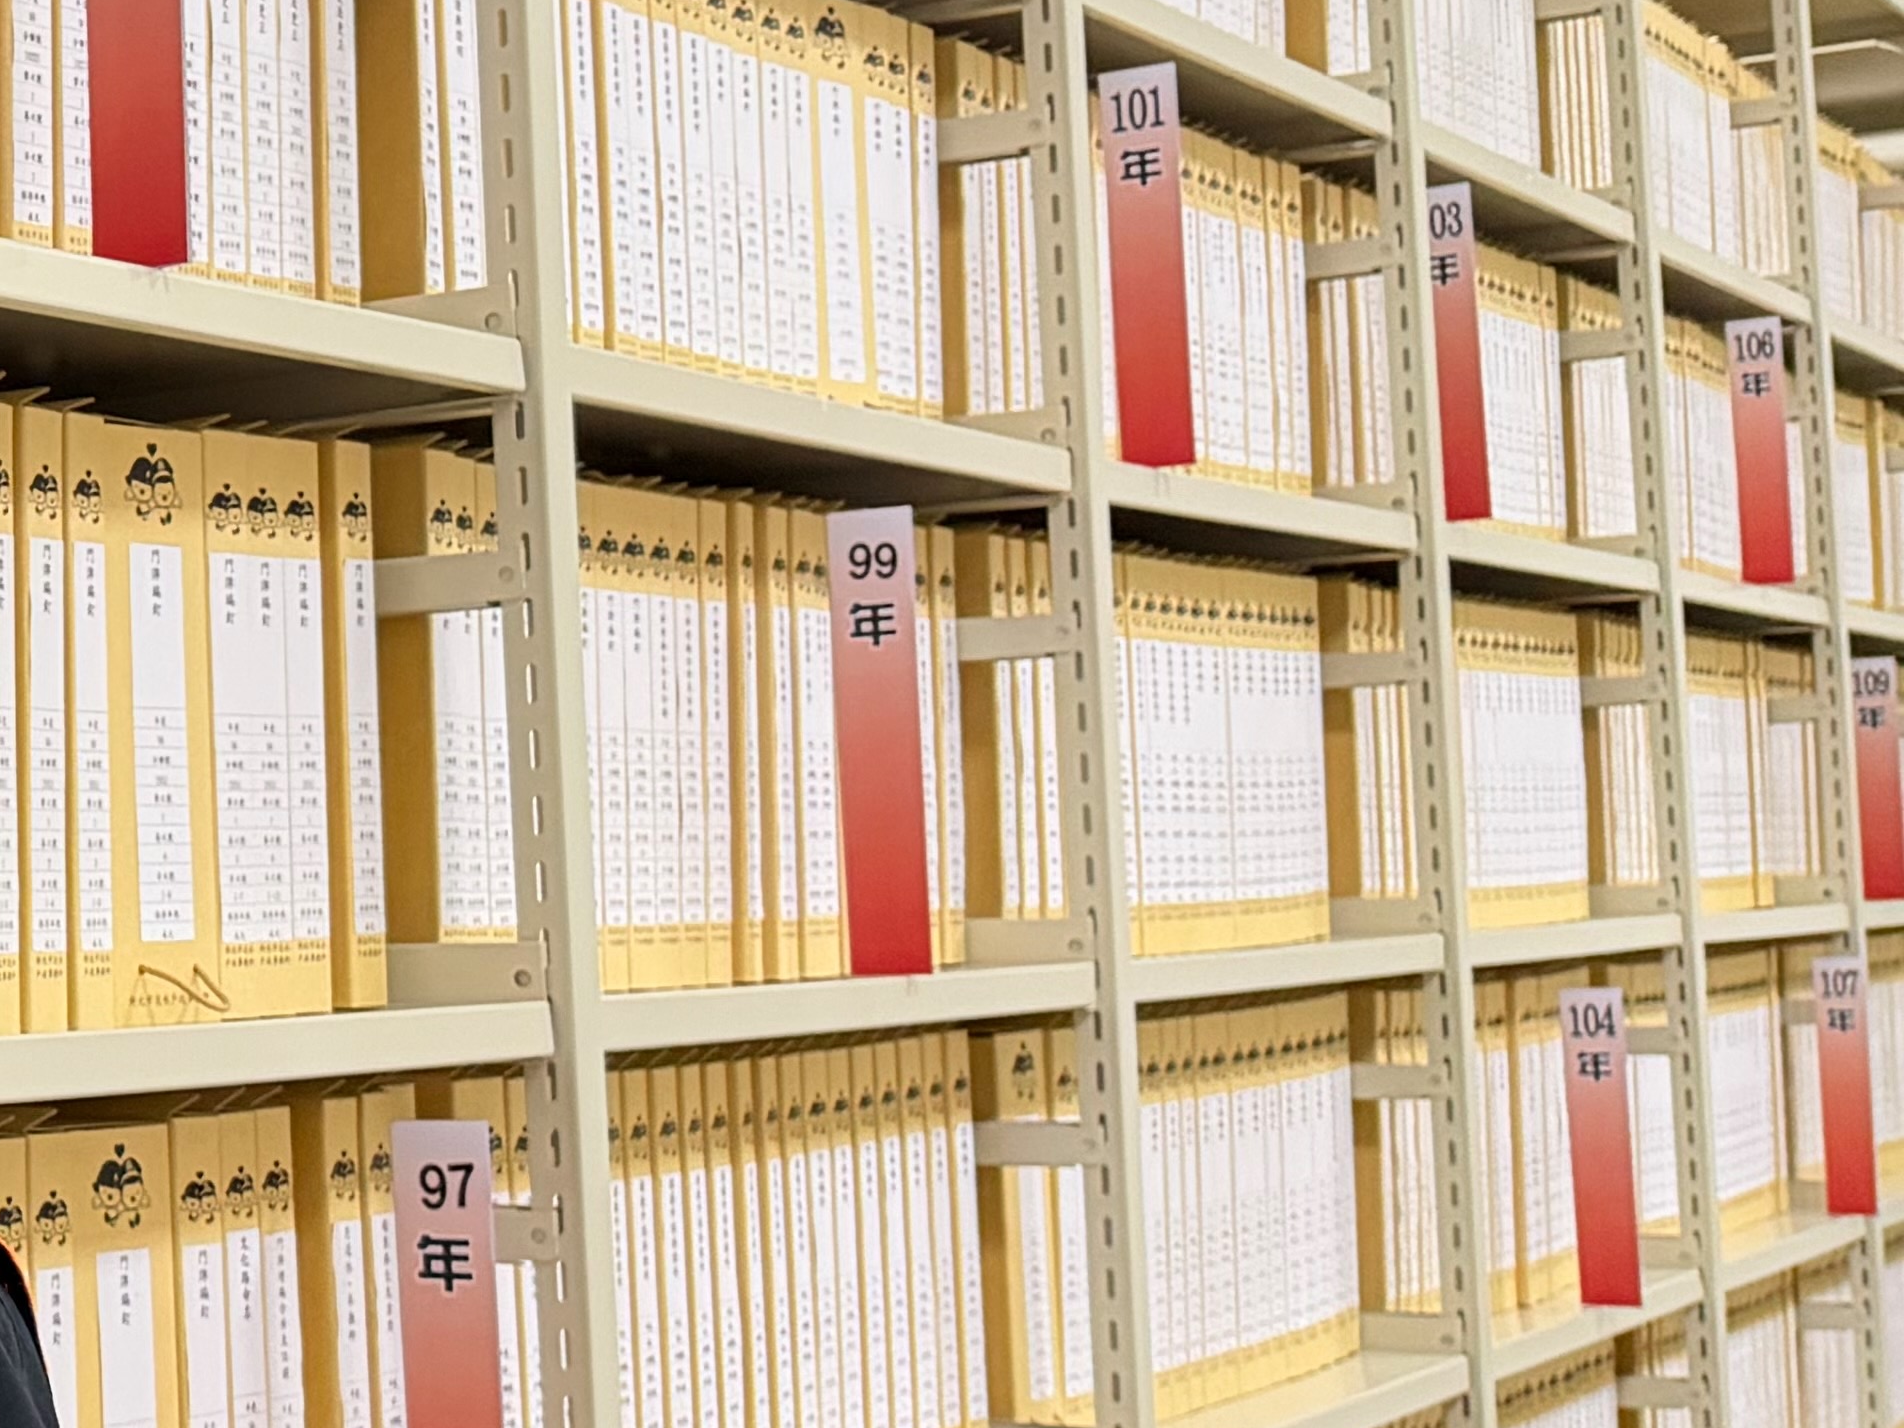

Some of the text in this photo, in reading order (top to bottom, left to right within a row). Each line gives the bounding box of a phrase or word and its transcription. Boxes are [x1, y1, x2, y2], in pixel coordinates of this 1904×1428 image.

[1109, 87, 1164, 135] 101
[1120, 148, 1162, 186] 年
[1429, 202, 1464, 239] 03
[1430, 254, 1460, 286] 年
[1735, 330, 1774, 360] 106
[1742, 371, 1772, 397] 年
[848, 542, 898, 580] 99
[850, 603, 896, 645] 年
[1852, 669, 1889, 696] 109
[1859, 706, 1885, 728] 年
[1821, 969, 1858, 998] 107
[1568, 1003, 1615, 1038] 104
[1828, 1008, 1855, 1031] 年
[1578, 1050, 1612, 1081] 年
[419, 1163, 474, 1210] 97
[417, 1234, 474, 1292] 年
